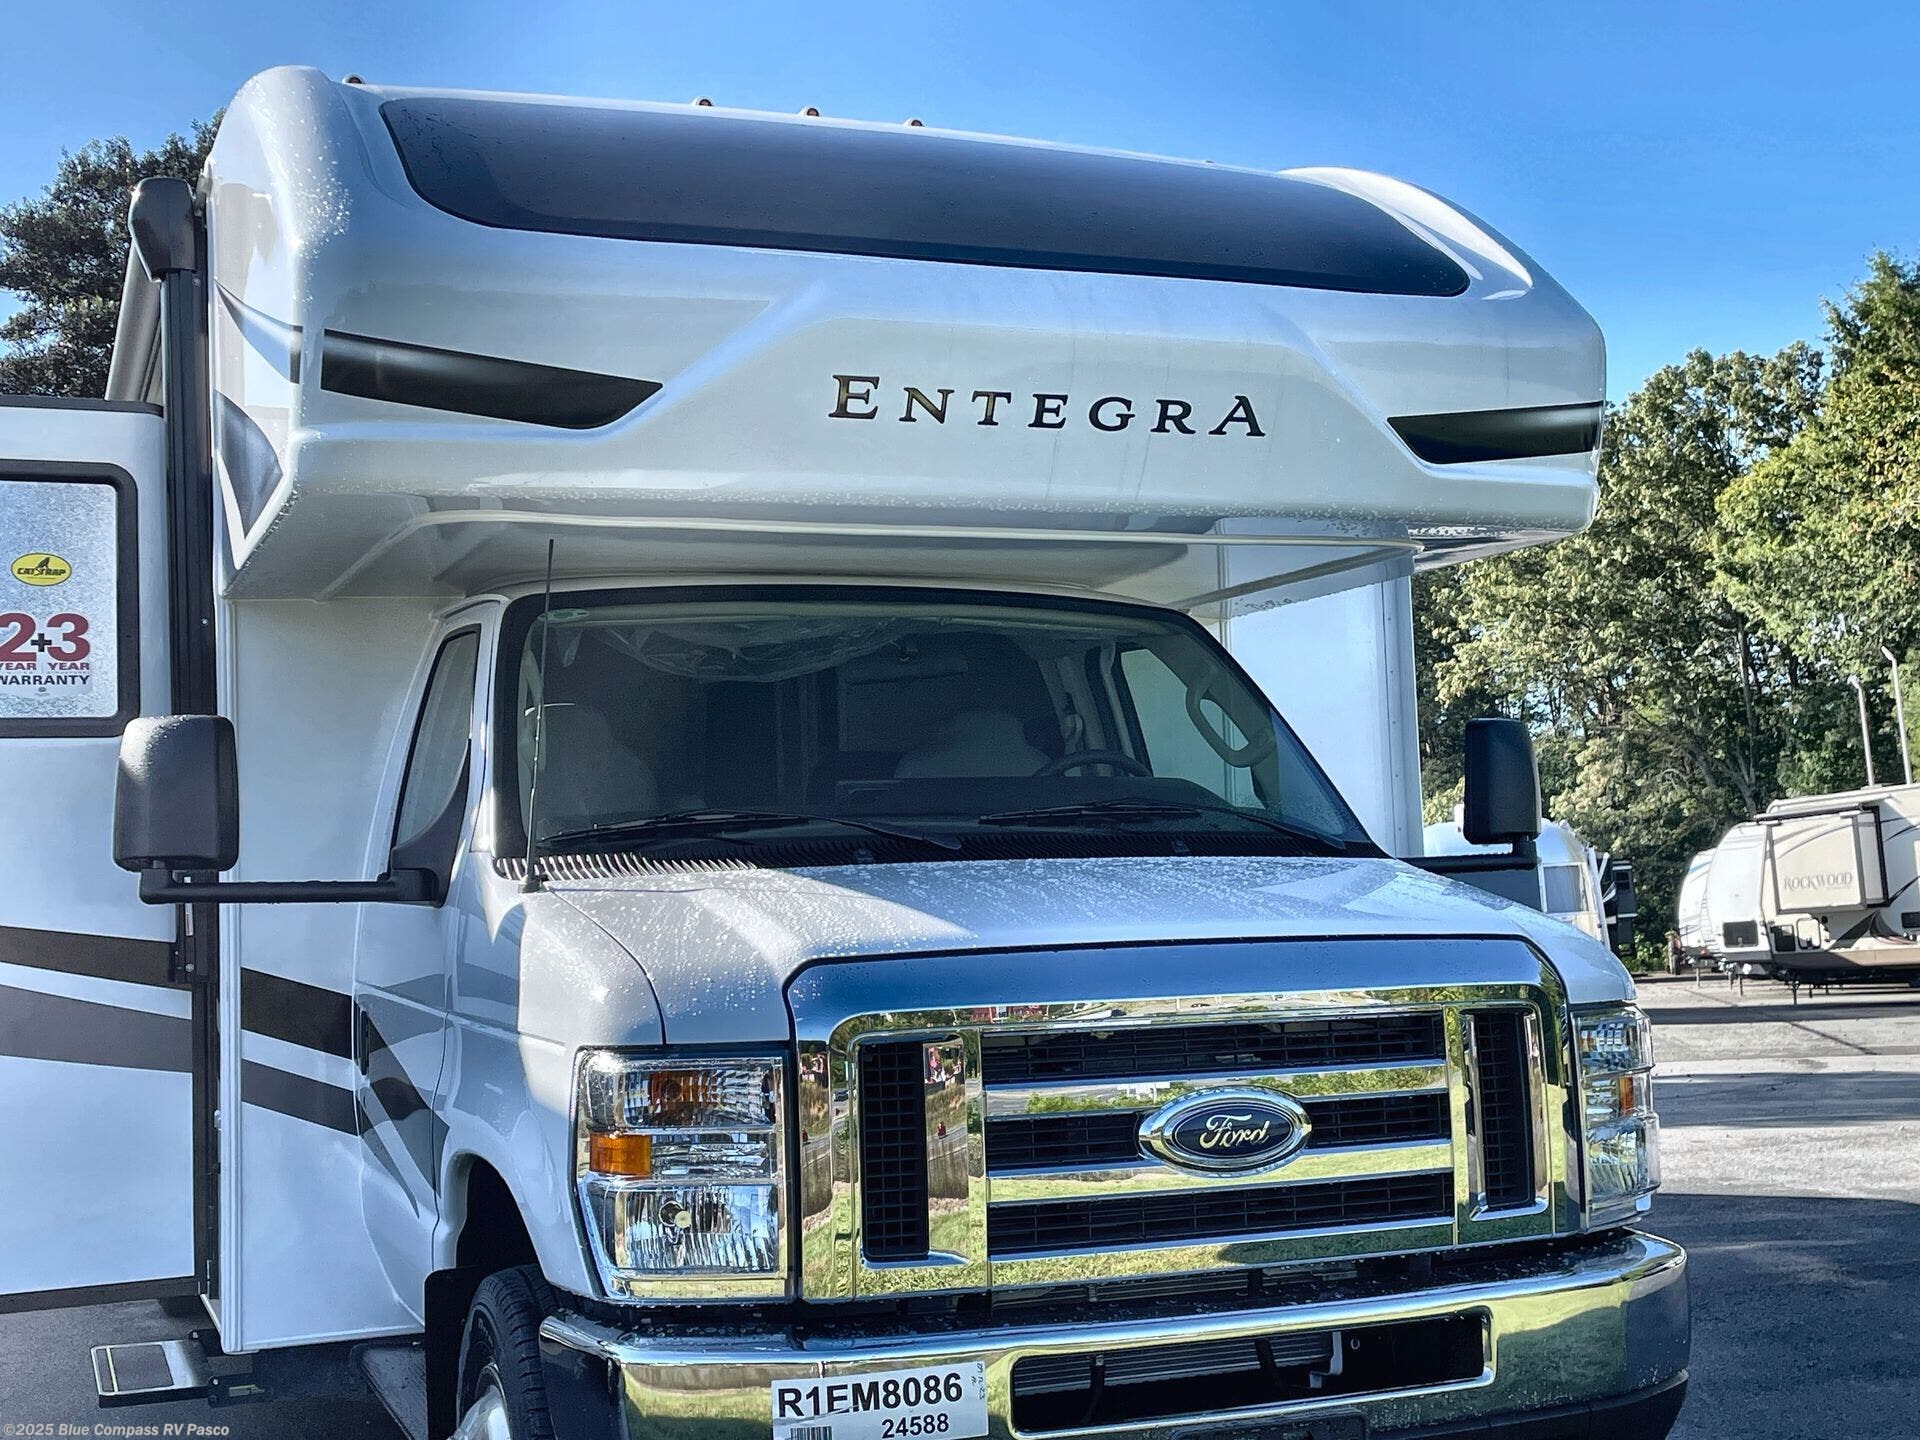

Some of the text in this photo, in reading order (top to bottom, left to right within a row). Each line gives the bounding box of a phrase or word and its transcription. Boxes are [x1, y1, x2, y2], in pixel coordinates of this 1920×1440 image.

[828, 374, 1266, 437] ENTEGRA
[1784, 872, 1853, 890] ROCKWOOD
[1200, 1114, 1270, 1149] Ford
[777, 1372, 963, 1418] R1EM8086
[881, 1412, 949, 1439] 24588
